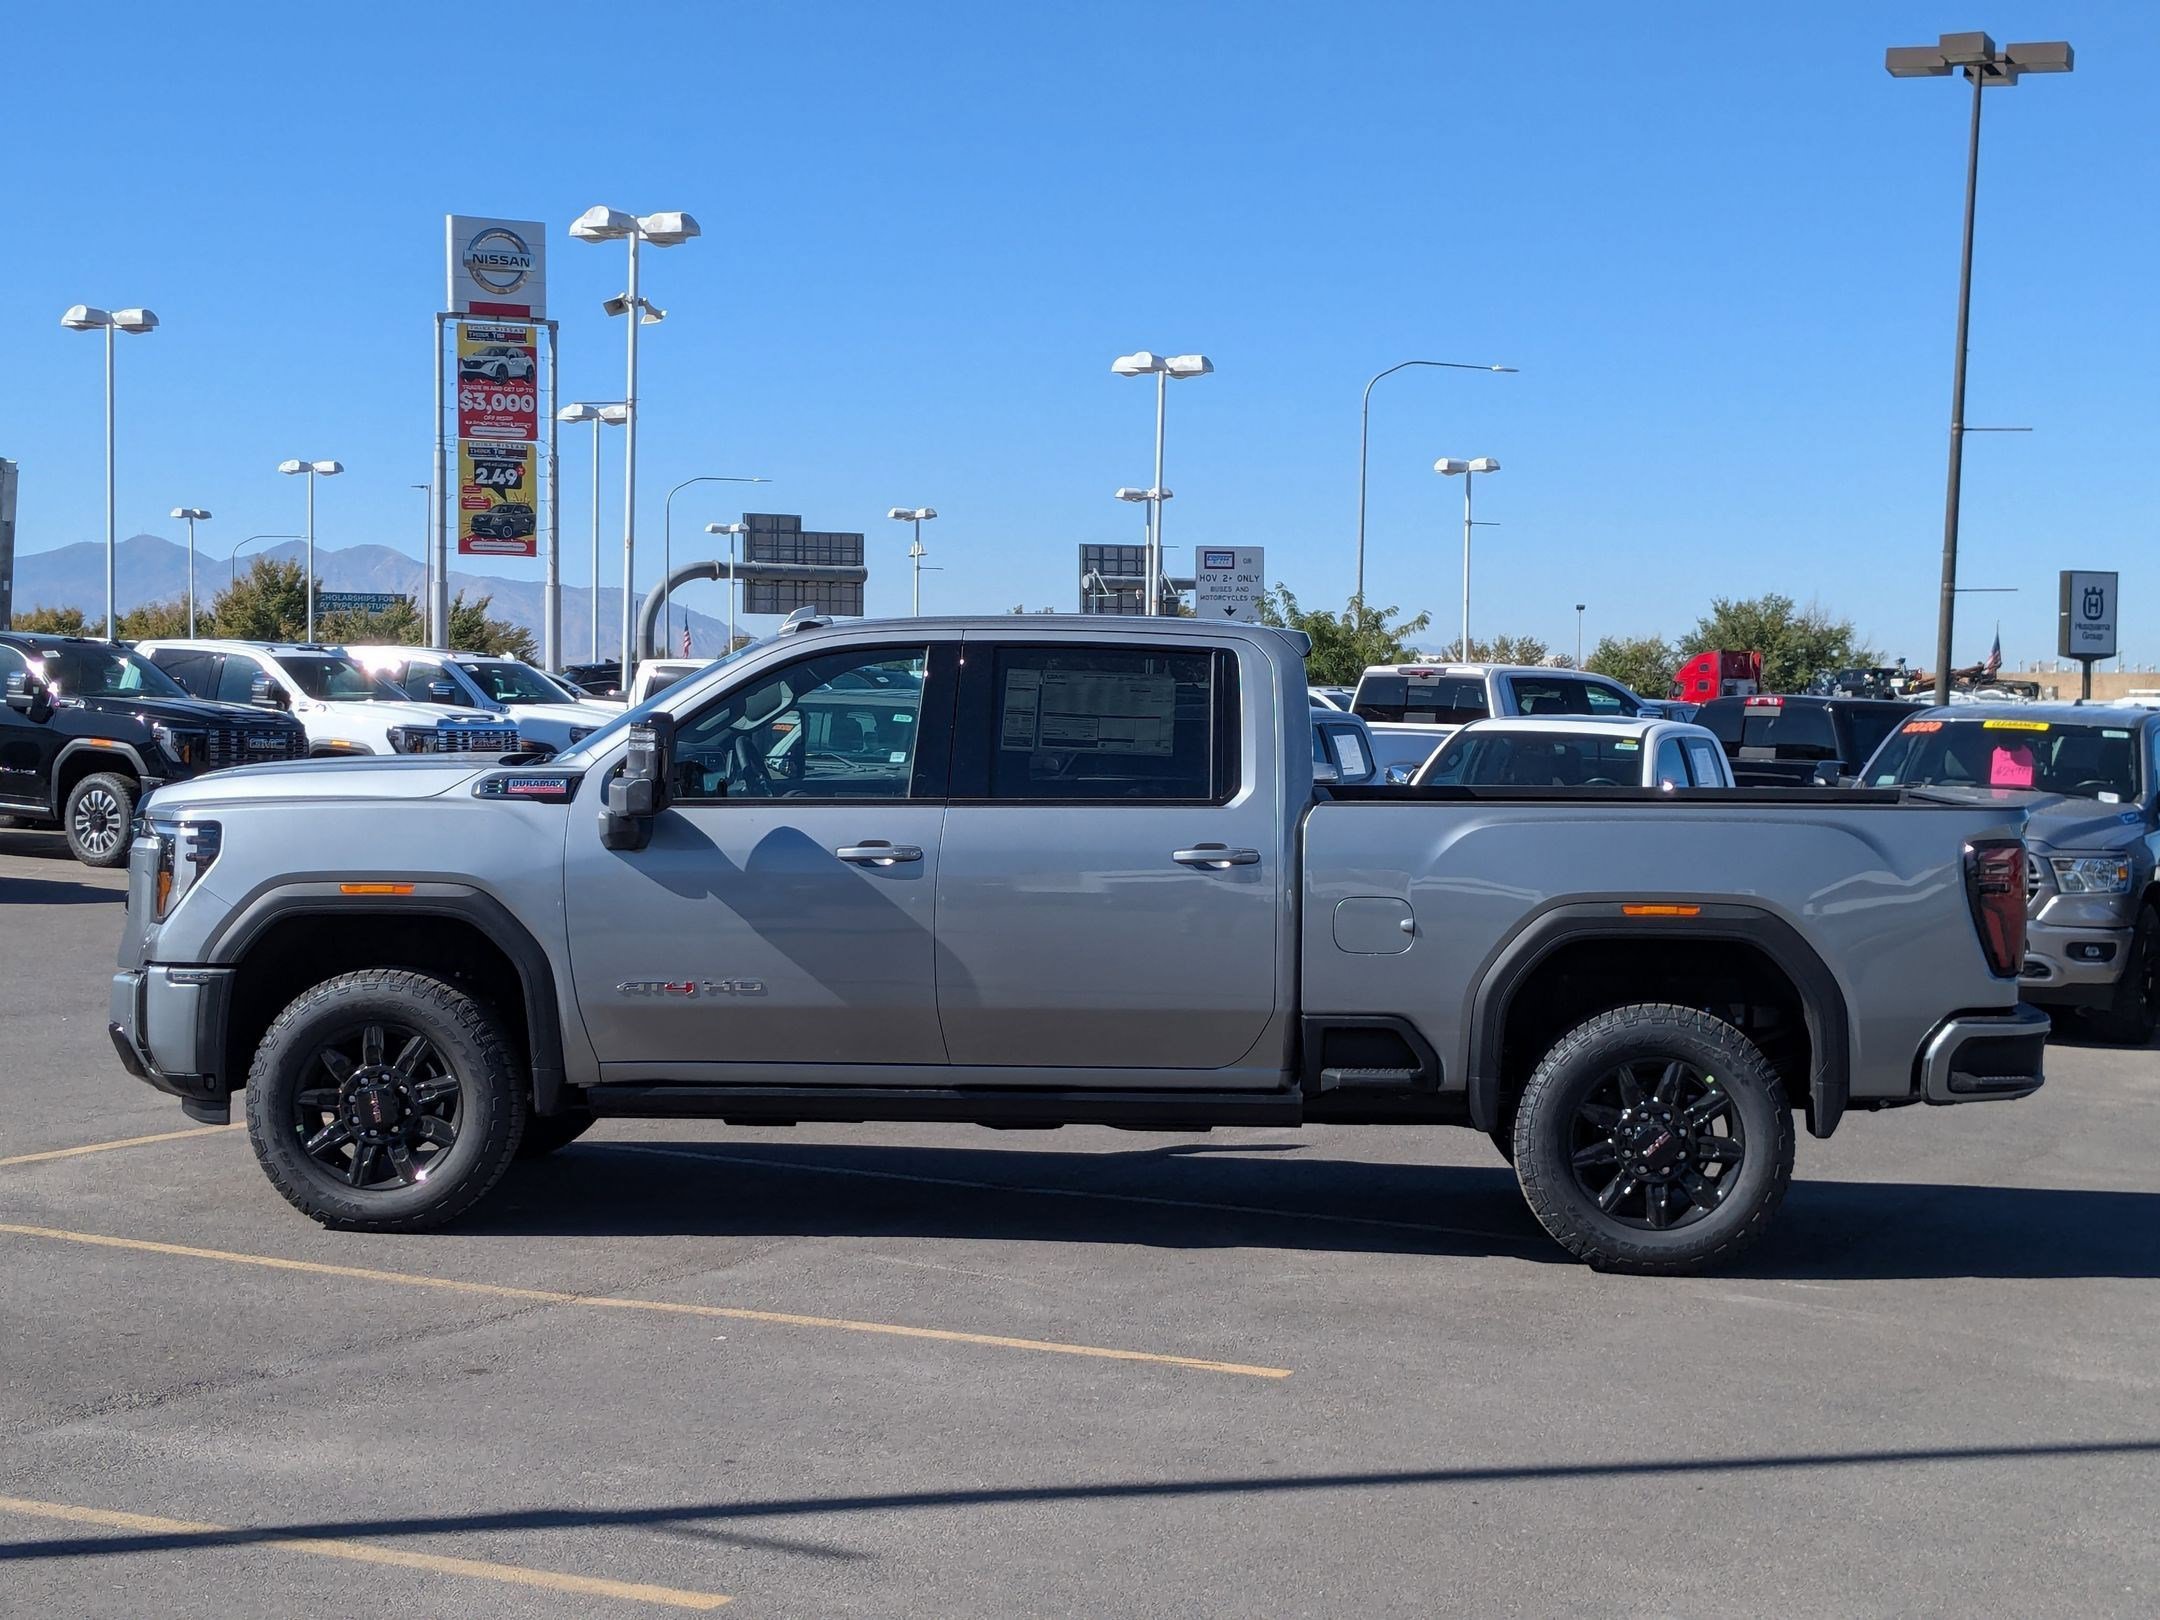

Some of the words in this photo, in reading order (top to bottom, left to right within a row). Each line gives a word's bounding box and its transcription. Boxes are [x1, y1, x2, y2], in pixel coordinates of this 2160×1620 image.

[472, 253, 530, 268] NISSAN
[460, 389, 535, 414] $3,000
[475, 467, 518, 486] 2.49
[1200, 574, 1217, 582] HOV
[1237, 574, 1260, 582] ONLY
[511, 779, 566, 788] DURAMAX
